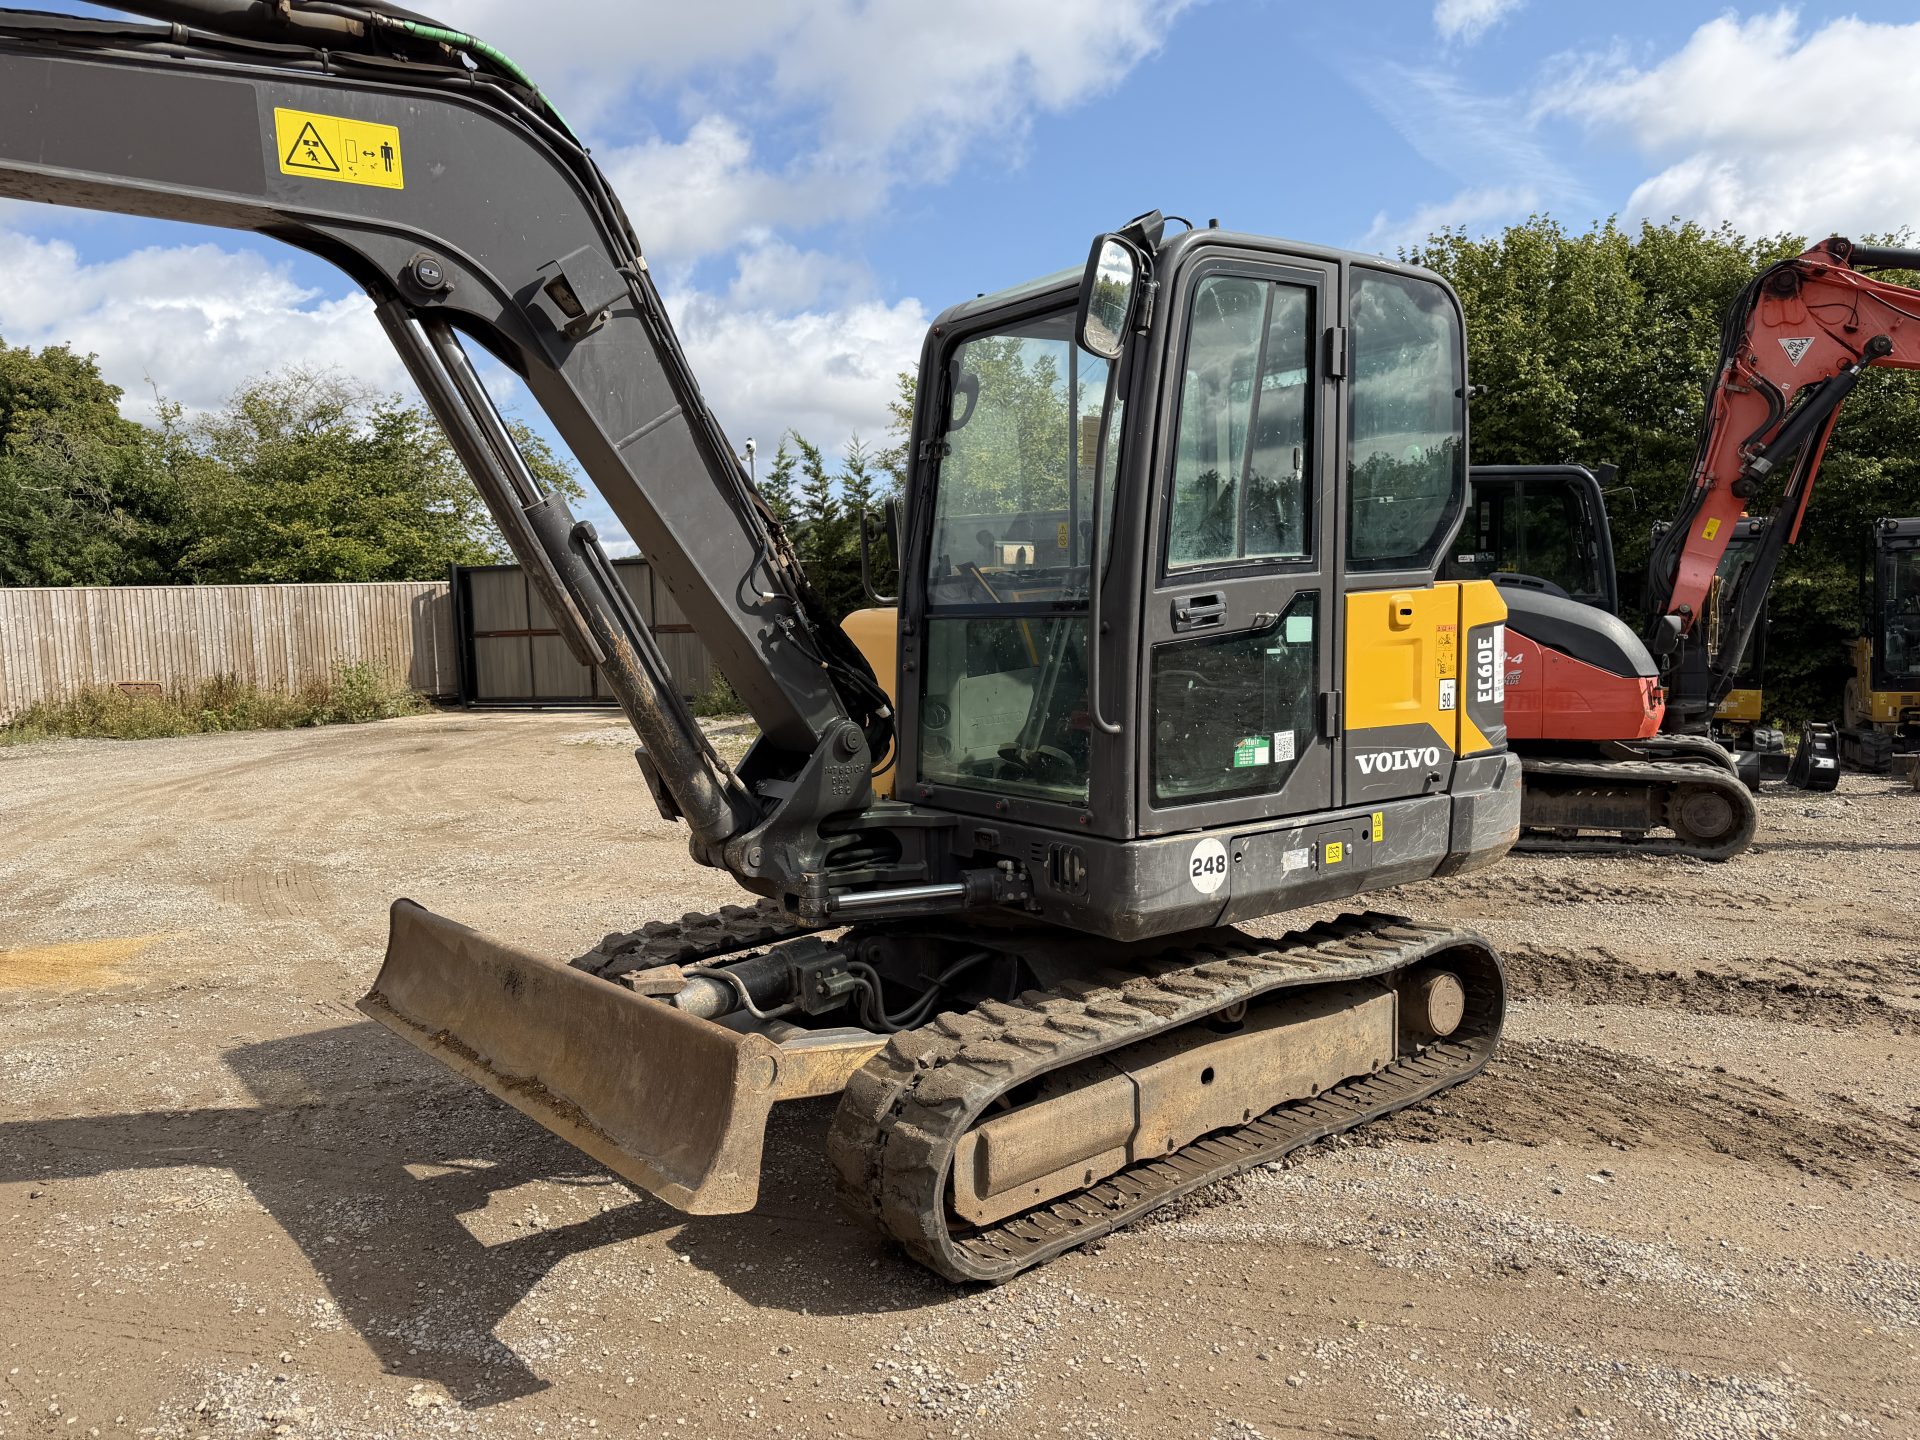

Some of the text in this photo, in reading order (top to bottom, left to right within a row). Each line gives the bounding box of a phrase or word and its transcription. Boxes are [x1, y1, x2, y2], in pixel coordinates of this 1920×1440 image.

[1477, 636, 1493, 703] EC60E
[1442, 692, 1451, 708] 98
[1355, 747, 1440, 775] VOLVO
[1192, 854, 1226, 878] 248
